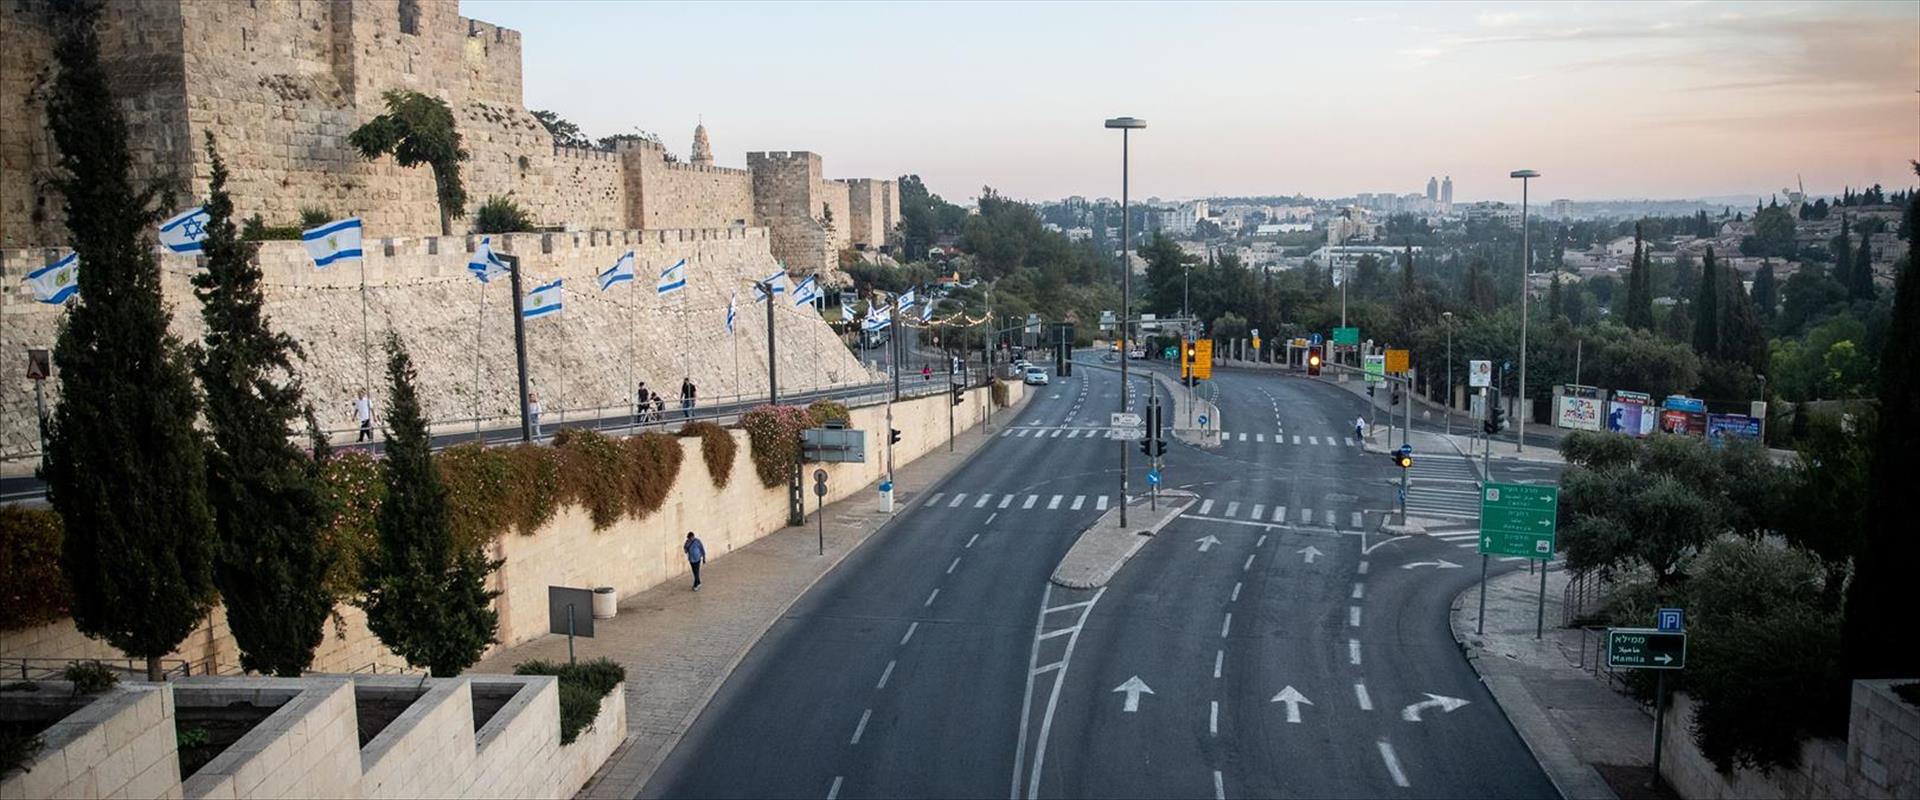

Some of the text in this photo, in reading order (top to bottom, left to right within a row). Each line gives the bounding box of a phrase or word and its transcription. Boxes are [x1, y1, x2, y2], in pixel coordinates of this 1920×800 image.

[1667, 615, 1676, 629] P
[1614, 635, 1646, 644] ממילא
[1612, 655, 1645, 663] Mamila
